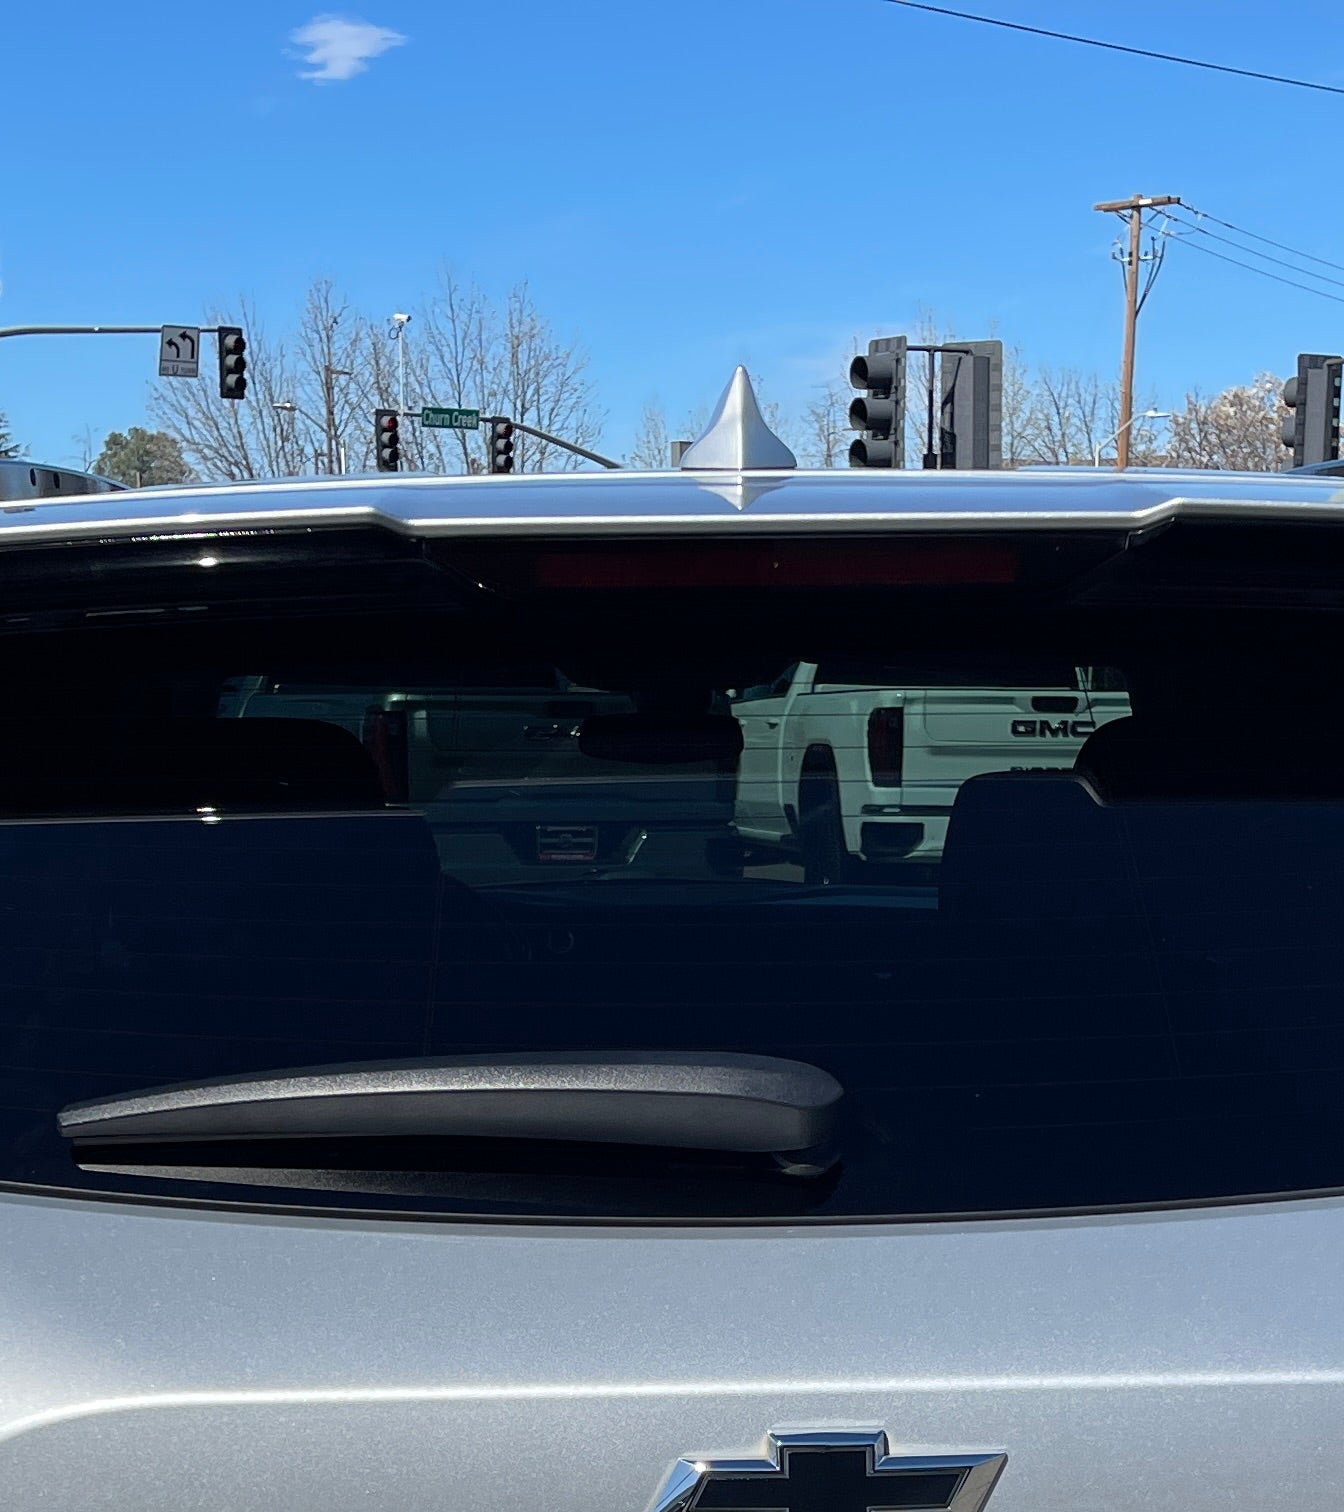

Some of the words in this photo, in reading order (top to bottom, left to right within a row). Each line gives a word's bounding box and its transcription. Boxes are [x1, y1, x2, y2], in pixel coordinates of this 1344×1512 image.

[423, 409, 450, 427] Churn
[452, 411, 479, 428] Creek
[1011, 719, 1096, 738] GMC
